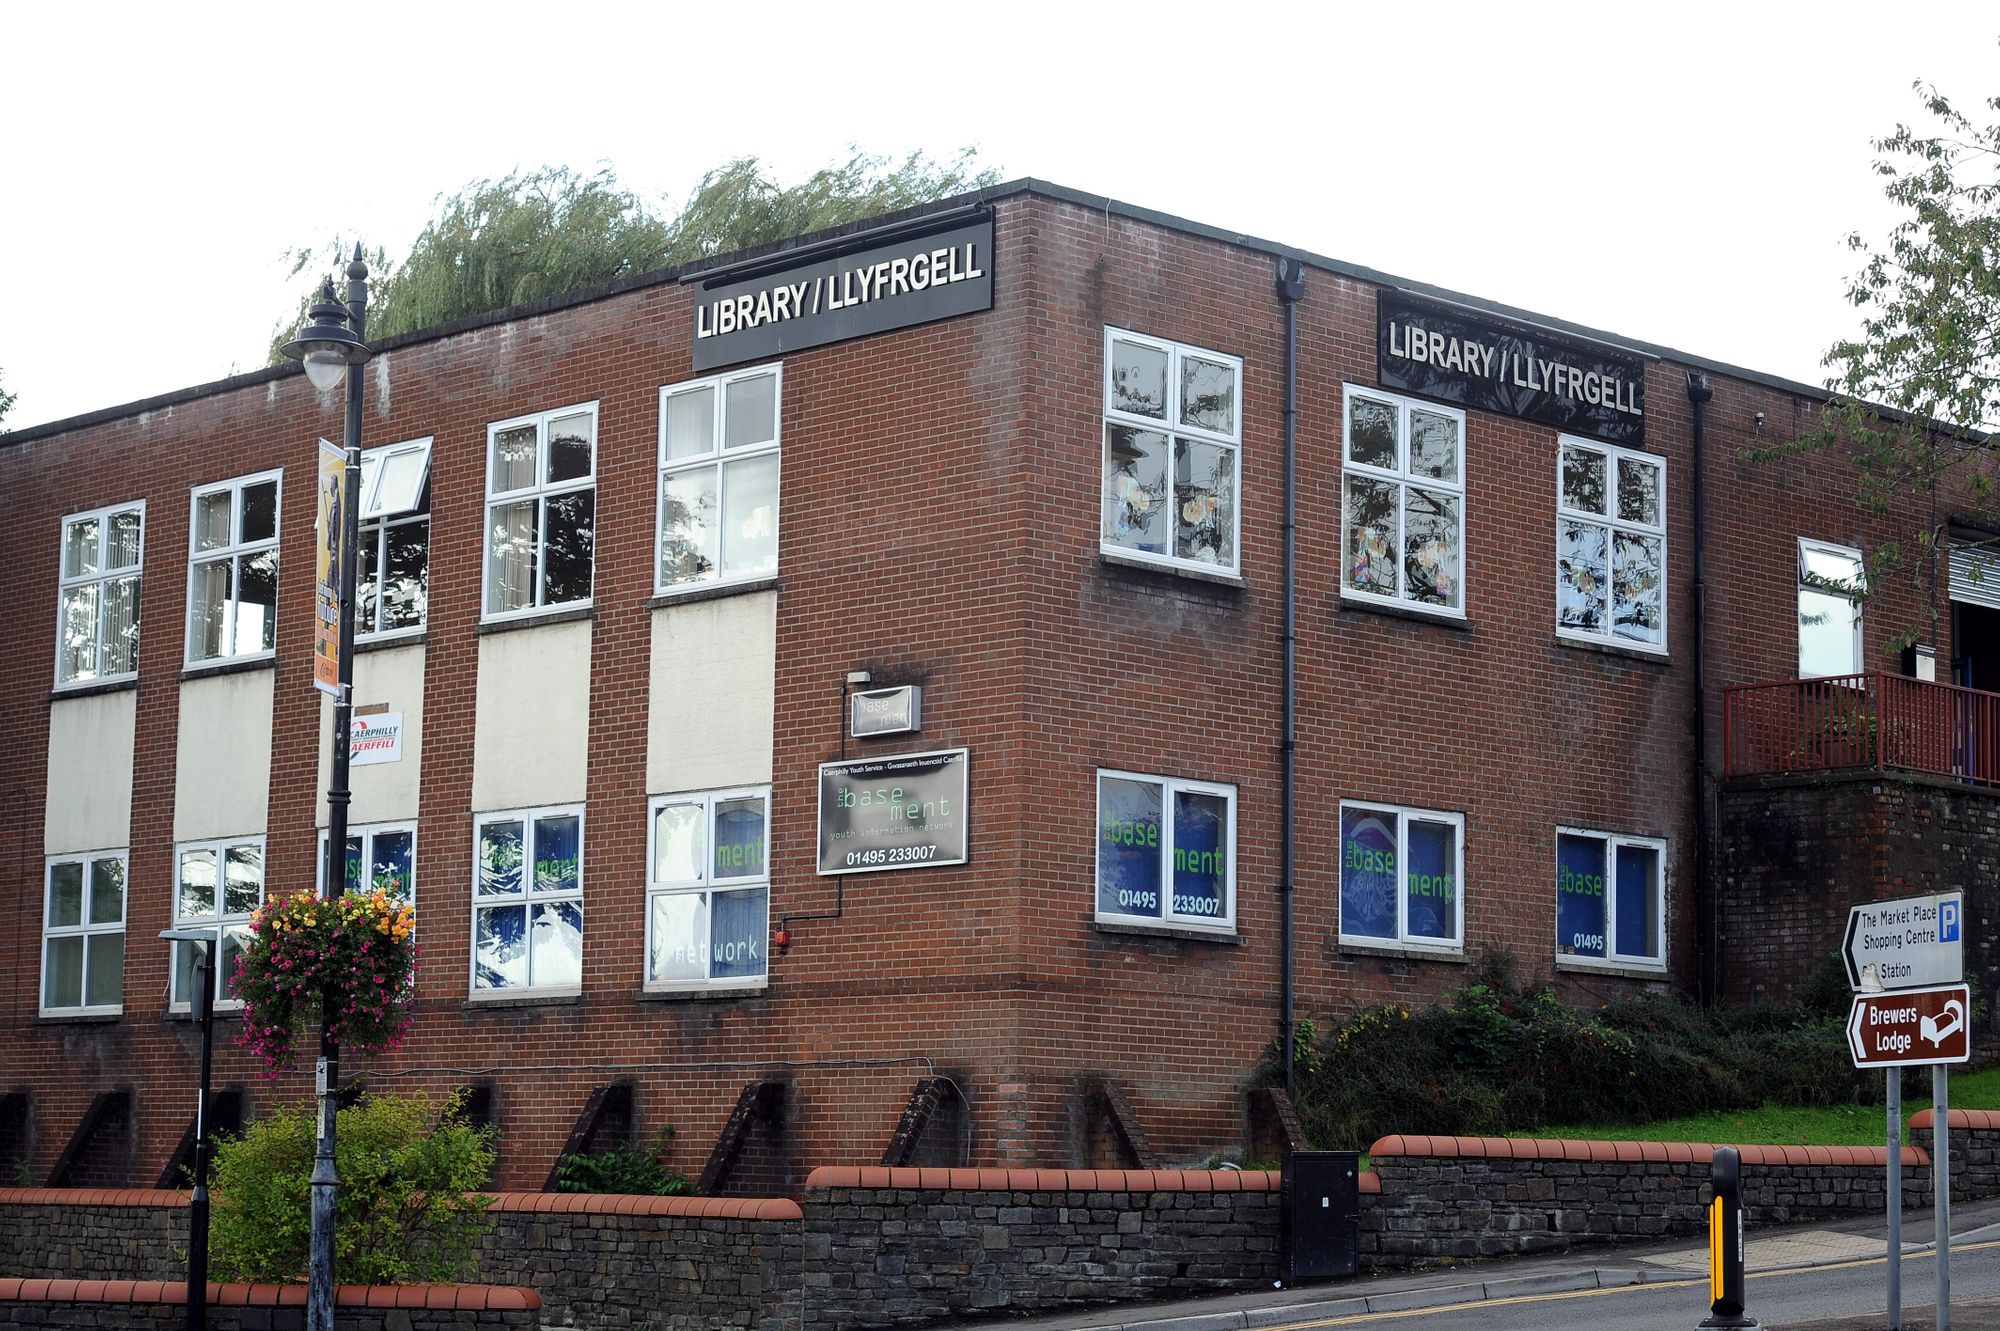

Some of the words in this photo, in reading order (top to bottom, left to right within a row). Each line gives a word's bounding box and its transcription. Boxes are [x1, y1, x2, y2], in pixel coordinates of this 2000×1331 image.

[697, 281, 807, 338] LIBRARY
[812, 277, 825, 314] /
[828, 243, 982, 310] LLYFRGELL
[1390, 322, 1494, 378] LIBRARY
[1500, 350, 1507, 382] /
[1513, 353, 1642, 416] LLYFRGELL
[351, 740, 395, 752] AERFFILI
[823, 766, 849, 777] Caerphilly
[849, 765, 864, 774] Youth
[865, 764, 883, 772] Service
[844, 787, 903, 808] base
[890, 796, 950, 820] ment
[830, 829, 856, 840] youth
[861, 825, 914, 837] information
[919, 821, 953, 832] network
[1111, 810, 1157, 848] base
[718, 836, 764, 868] ment
[847, 850, 886, 866] 01495
[889, 845, 937, 862] 233007
[1174, 847, 1225, 876] ment
[1353, 840, 1394, 875] base
[1408, 871, 1453, 901] ment
[1566, 865, 1602, 896] base
[1119, 888, 1157, 909] 01495
[1173, 894, 1220, 915] 233007
[1862, 913, 1877, 928] The
[1880, 908, 1910, 925] Market
[1914, 906, 1937, 921] Place
[1942, 904, 1956, 939] P
[1573, 933, 1604, 950] 01495
[1864, 934, 1902, 951] Shopping
[1906, 928, 1935, 945] Centre
[1881, 962, 1911, 979] Station
[1870, 1005, 1917, 1026] Brewers
[1876, 1030, 1912, 1054] Lodge
